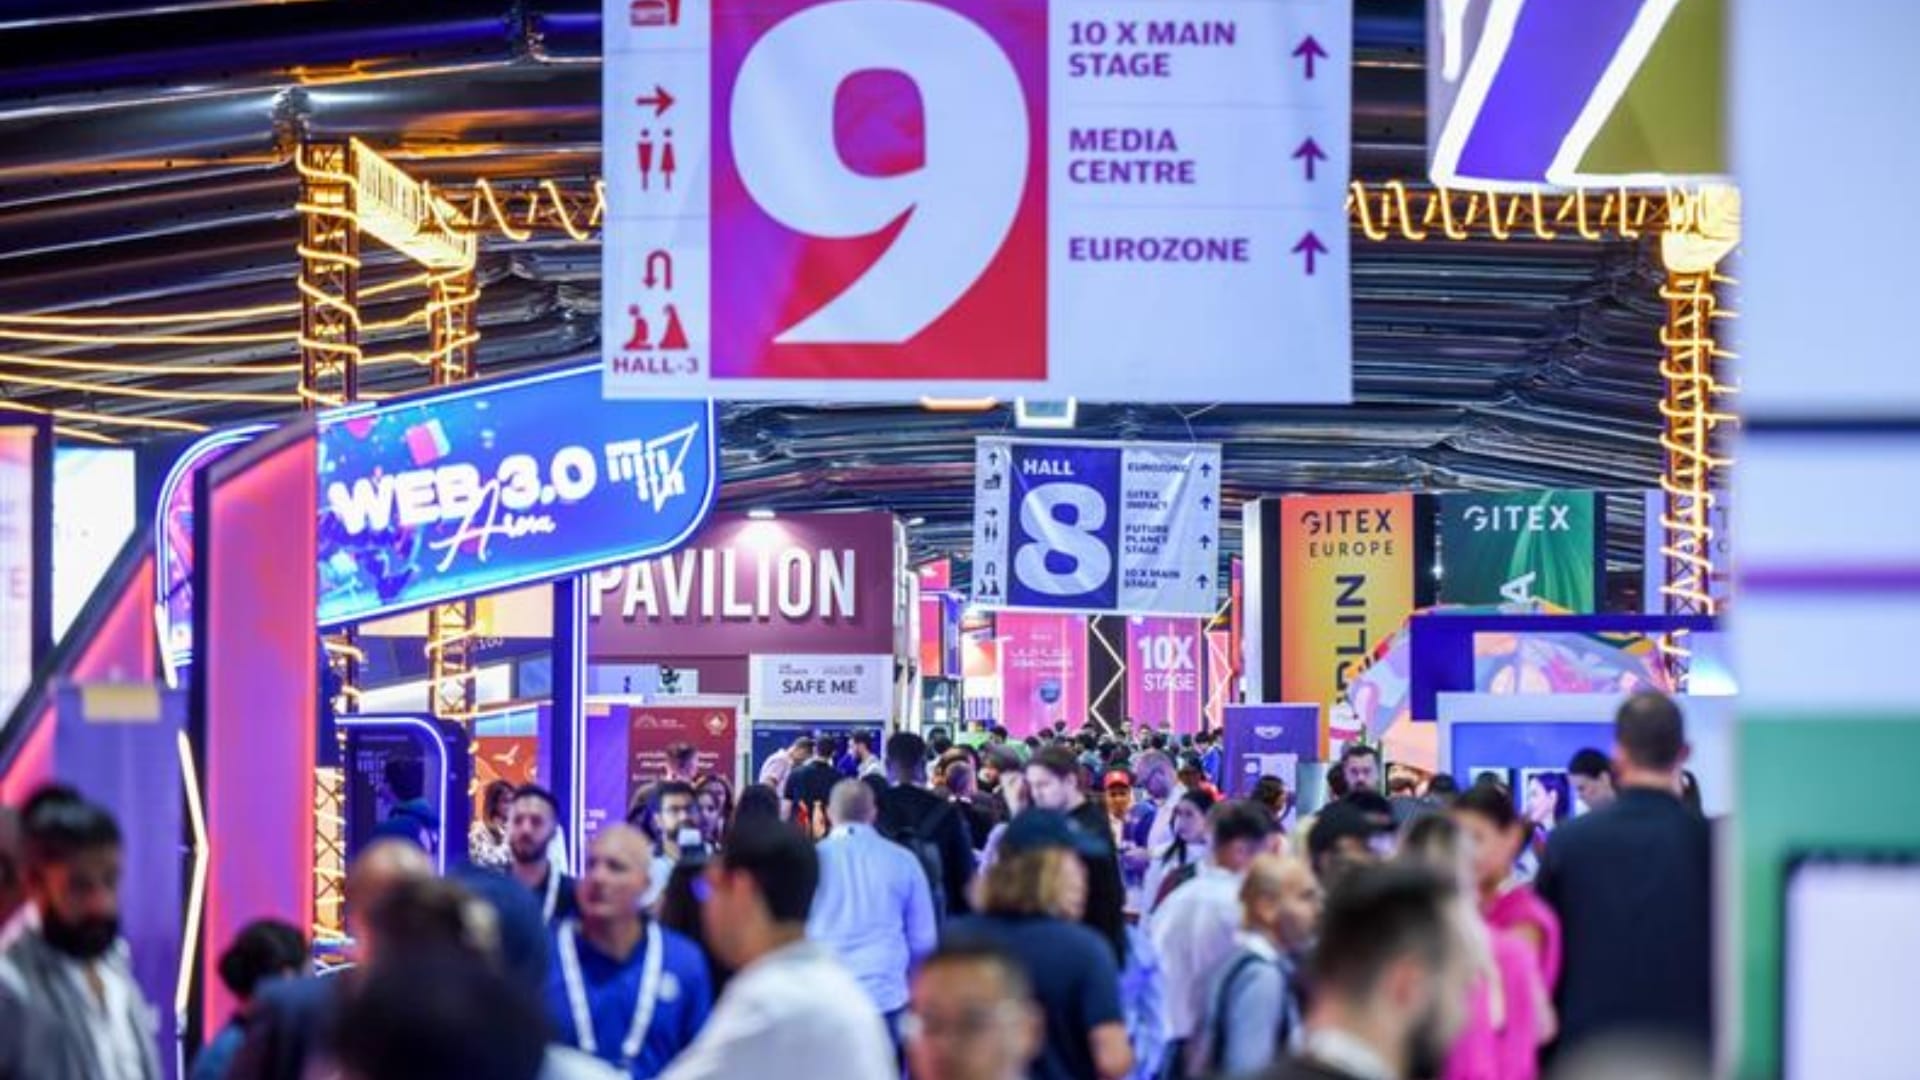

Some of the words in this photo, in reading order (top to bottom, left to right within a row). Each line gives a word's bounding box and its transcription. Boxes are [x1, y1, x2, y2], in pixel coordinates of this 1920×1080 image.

[1069, 21, 1107, 45] 10
[1117, 21, 1137, 45] X
[1147, 21, 1236, 46] MAIN
[1068, 52, 1171, 77] STAGE
[1069, 128, 1178, 152] MEDIA
[730, 0, 1030, 344] 9
[1068, 160, 1196, 184] CENTRE
[1069, 236, 1250, 262] EUROZONE
[612, 357, 699, 374] HALL-3
[1022, 459, 1075, 476] HALL
[327, 463, 481, 535] WEB
[497, 446, 597, 510] 3.0
[1301, 509, 1392, 535] GITEX
[1463, 505, 1571, 531] GITEX
[1014, 481, 1112, 596] 8
[1310, 541, 1394, 558] EUROPE
[589, 549, 856, 617] PAVILION
[1138, 636, 1194, 670] 10X
[782, 680, 826, 694] SAFE
[831, 680, 857, 694] ME
[1144, 673, 1195, 691] STAGE
